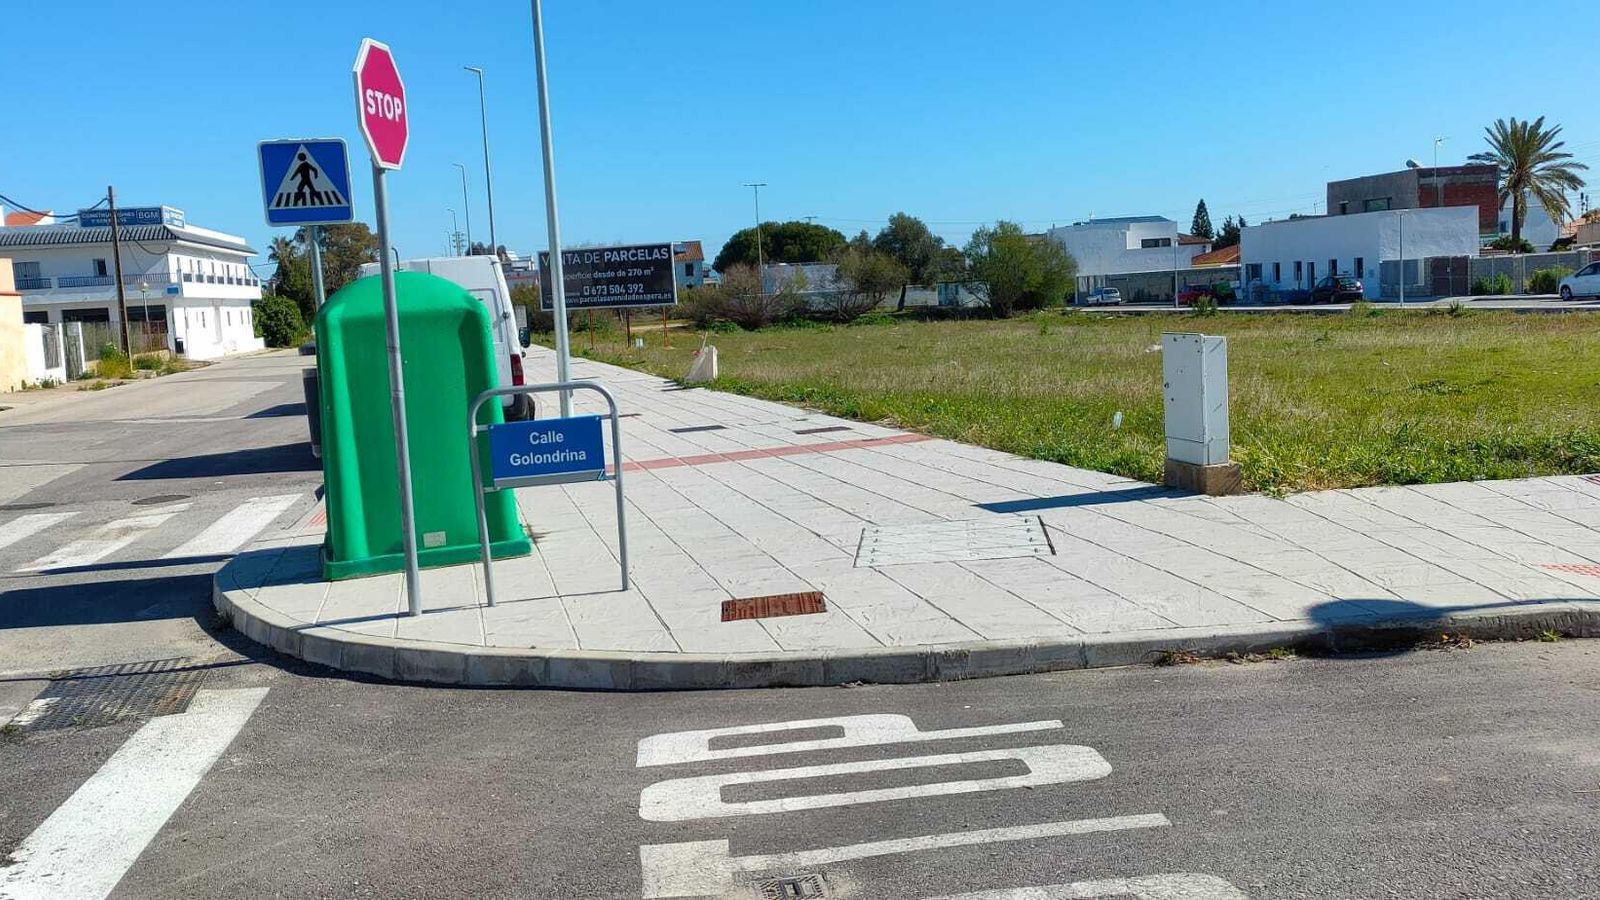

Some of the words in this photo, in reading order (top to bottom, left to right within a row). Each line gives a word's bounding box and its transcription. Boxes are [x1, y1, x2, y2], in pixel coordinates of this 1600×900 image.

[366, 88, 402, 122] STOP
[584, 251, 600, 264] DE
[604, 247, 670, 263] PARCELAS
[593, 269, 615, 279] desde
[616, 268, 626, 277] de
[627, 268, 642, 277] 270
[591, 285, 608, 296] 673
[609, 284, 626, 294] 504
[627, 283, 645, 294] 392
[529, 430, 565, 445] Calle
[509, 449, 588, 466] Golondrina
[636, 713, 1250, 900] TOP
